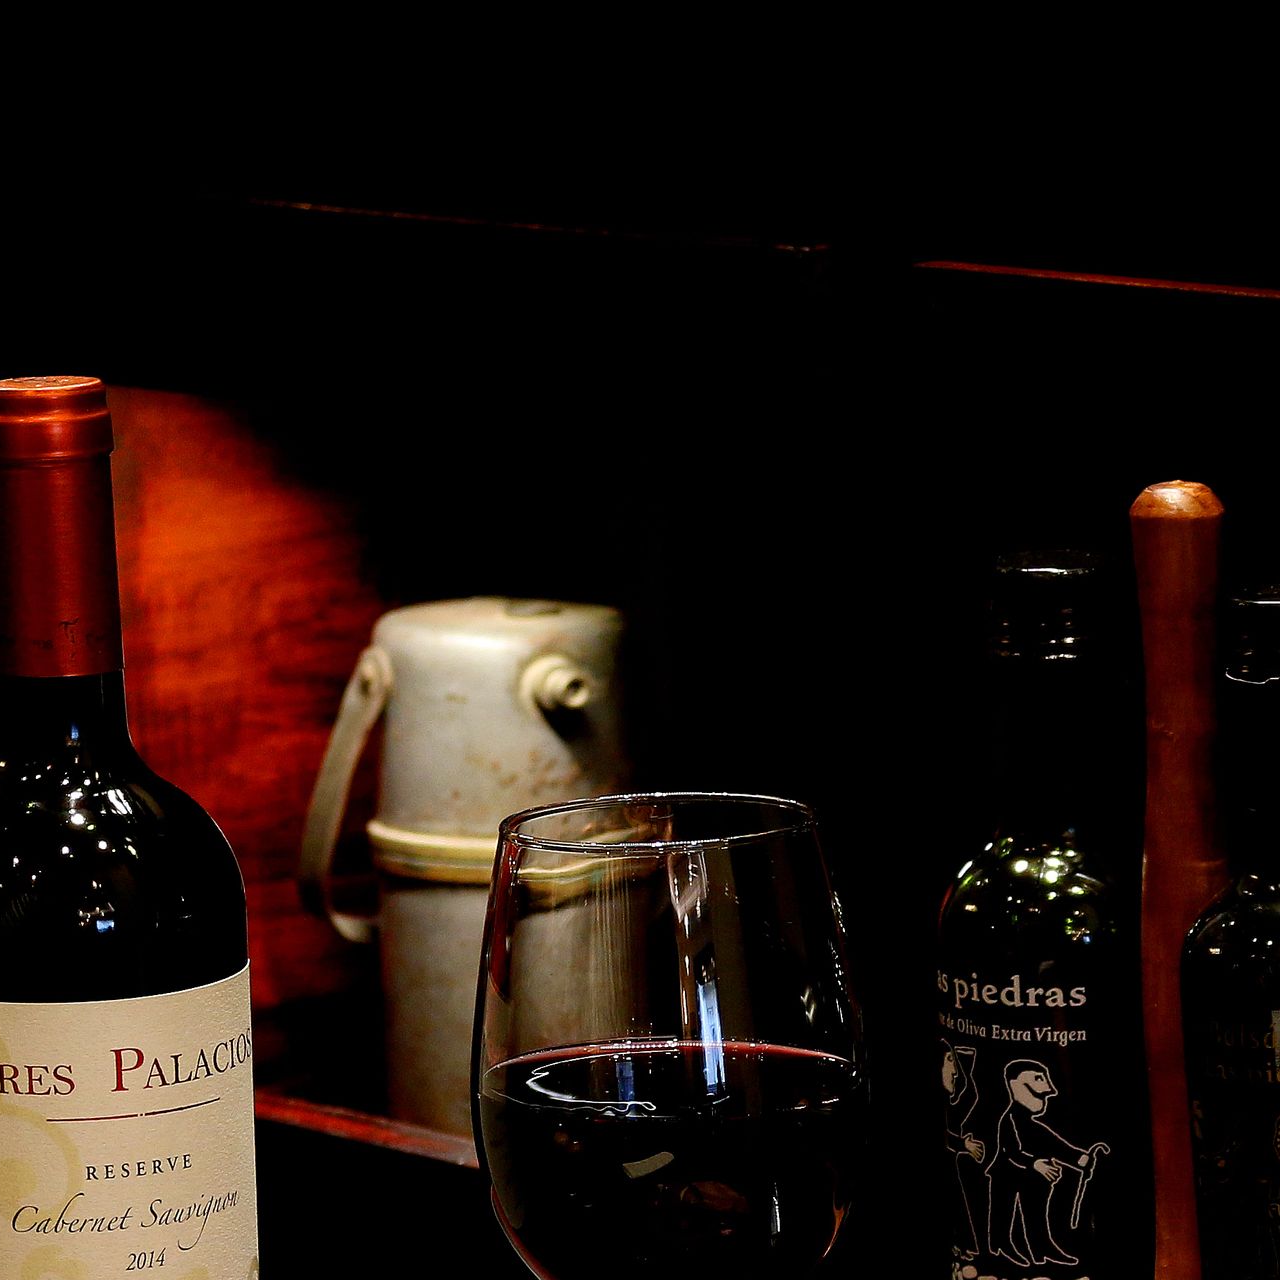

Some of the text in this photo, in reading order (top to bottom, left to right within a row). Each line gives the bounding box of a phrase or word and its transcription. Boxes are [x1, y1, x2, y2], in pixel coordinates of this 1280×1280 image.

[952, 971, 1088, 1010] piedras
[956, 1017, 987, 1038] Oliva
[991, 1024, 1031, 1042] Extra
[1033, 1026, 1087, 1048] Virgen
[109, 1027, 253, 1093] PALACIOS
[85, 1153, 193, 1181] RESERVE
[11, 1189, 239, 1251] Cabernet Sauvignon
[125, 1247, 167, 1271] 2014
